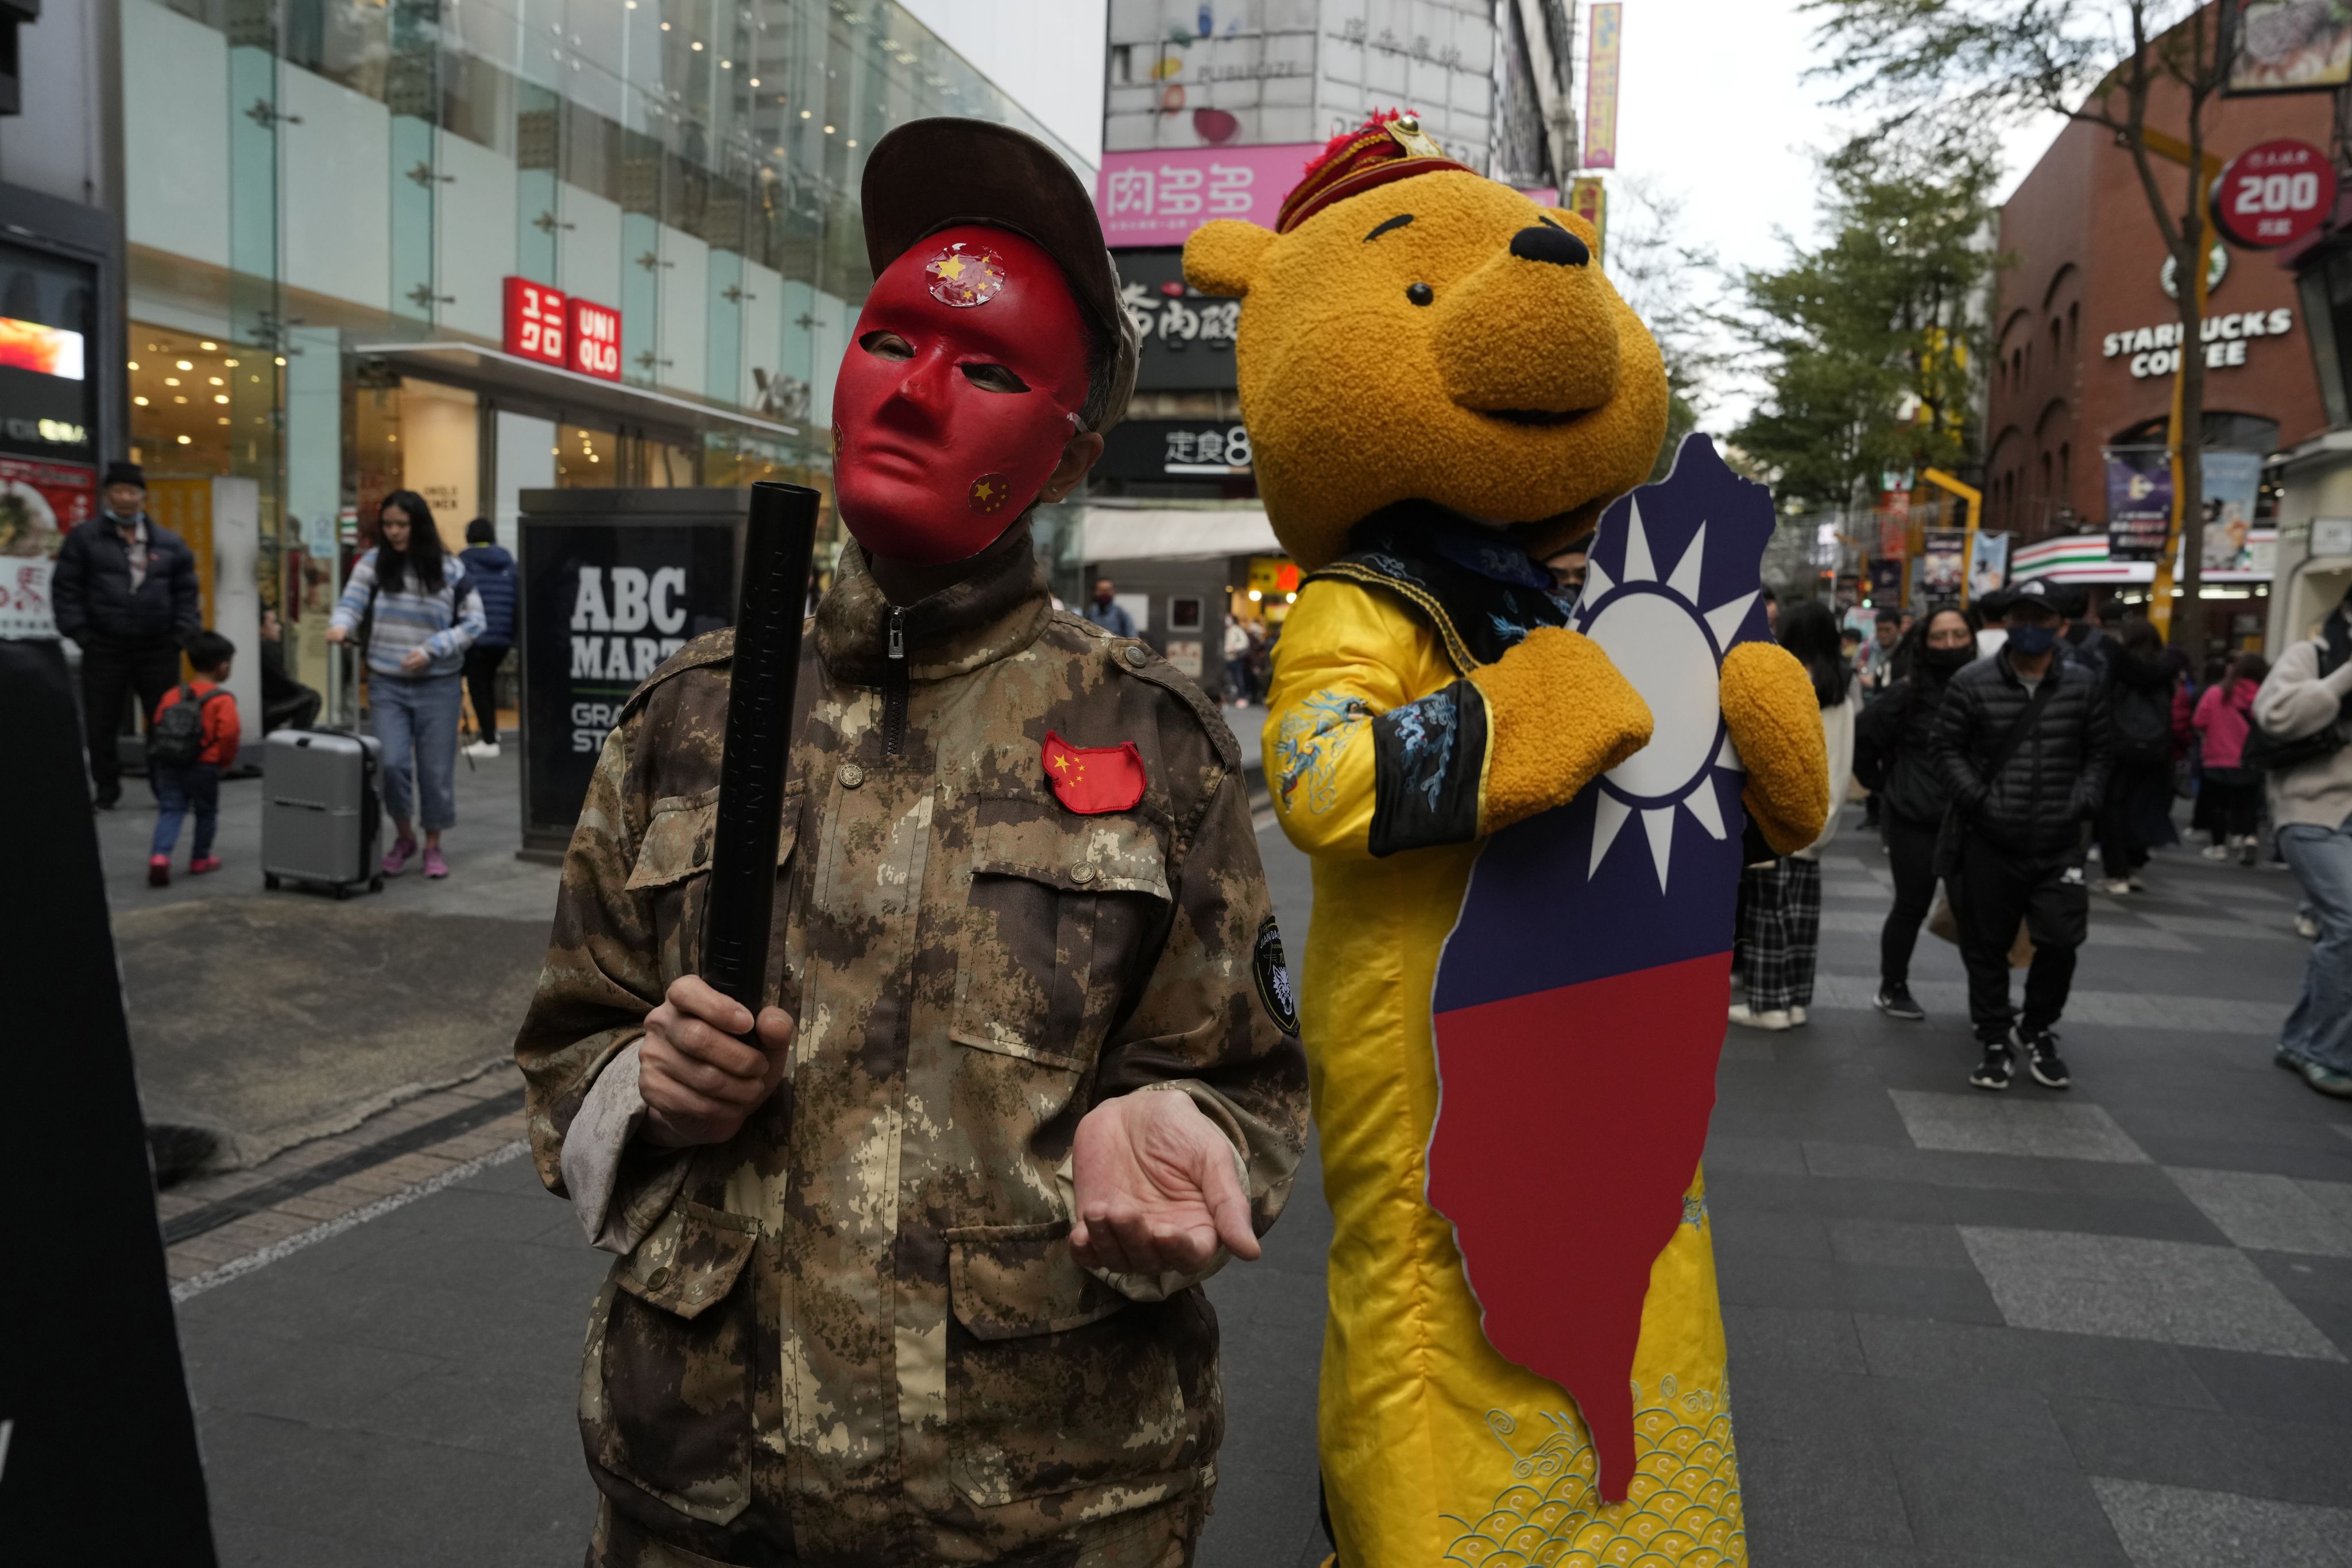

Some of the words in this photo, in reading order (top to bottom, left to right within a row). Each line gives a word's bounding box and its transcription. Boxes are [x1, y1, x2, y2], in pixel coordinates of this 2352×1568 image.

[1107, 162, 1255, 217] 肉多多
[2235, 173, 2319, 215] 200
[579, 307, 615, 343] UNI
[579, 338, 617, 373] QLO
[2130, 340, 2247, 378] COEE
[570, 566, 687, 635] ABC
[1260, 933, 1271, 948] JIAN
